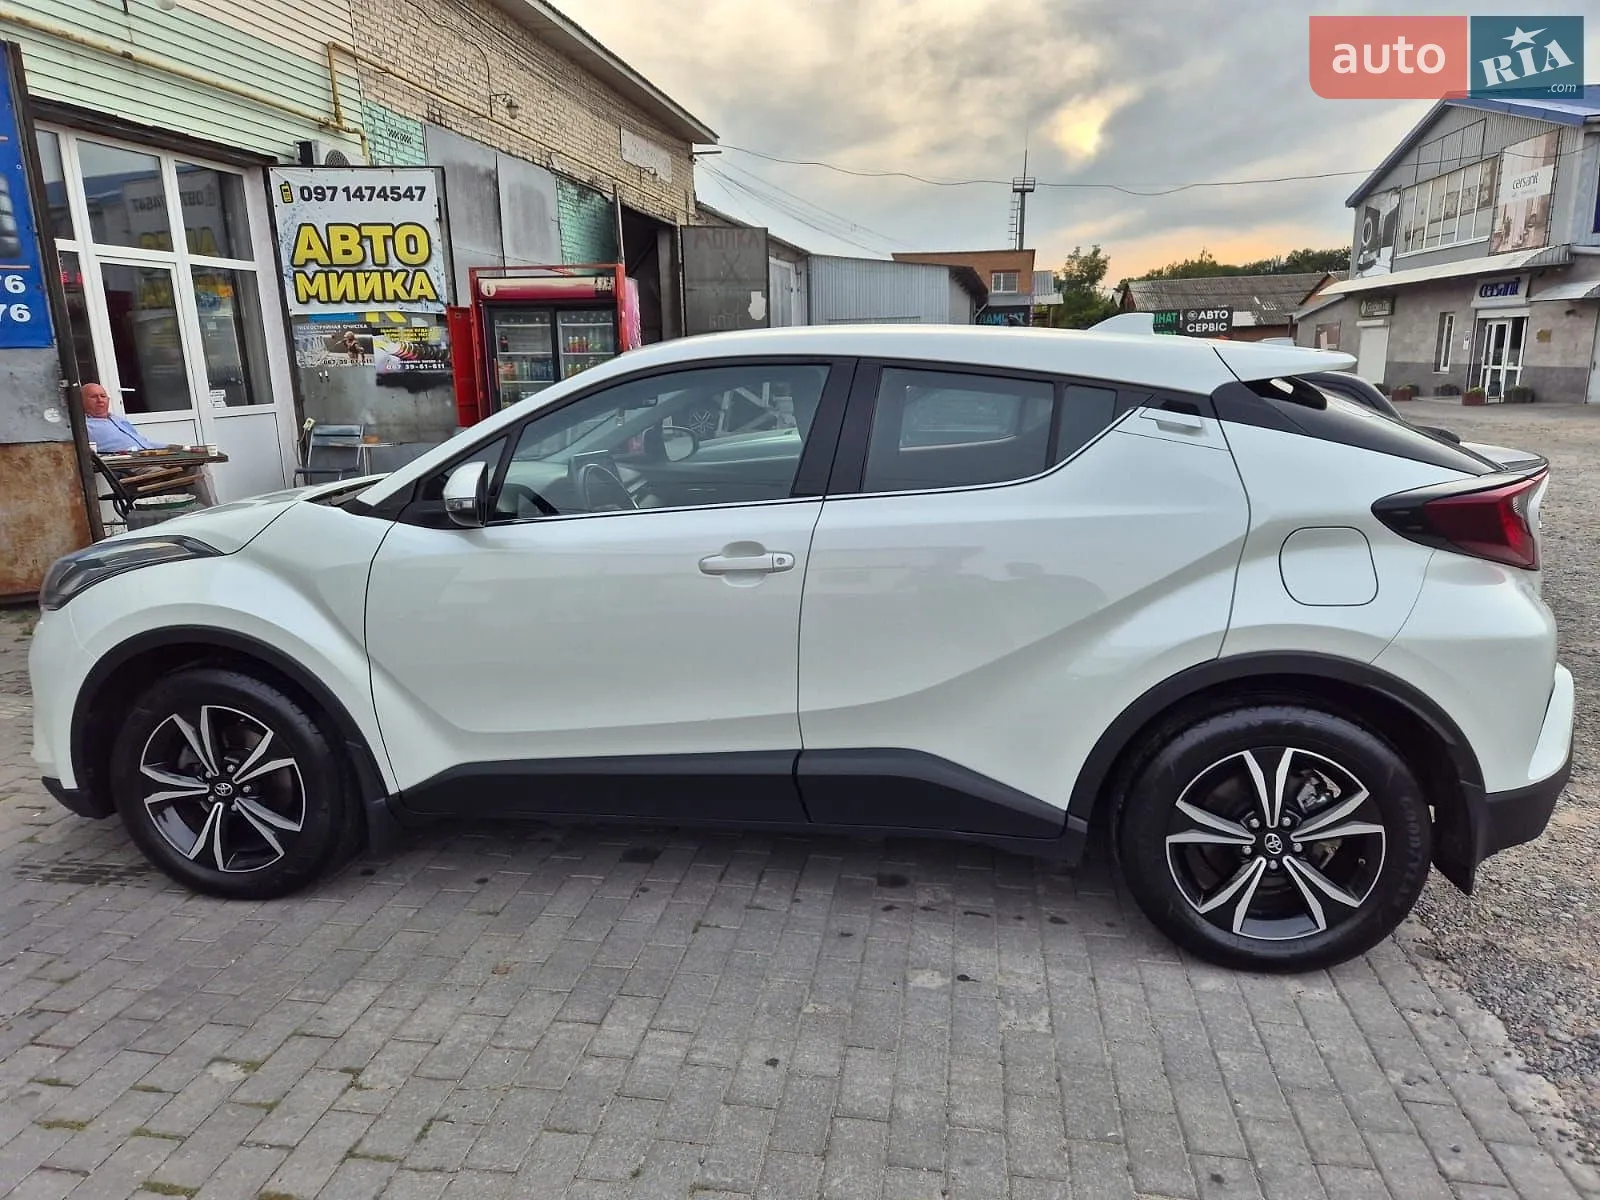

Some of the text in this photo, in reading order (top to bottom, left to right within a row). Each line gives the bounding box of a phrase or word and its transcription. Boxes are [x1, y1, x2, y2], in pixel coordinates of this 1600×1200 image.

[299, 185, 427, 202] 097 1474547
[290, 222, 432, 268] АВТО
[293, 269, 440, 304] МИЙКА
[1198, 310, 1229, 320] АВТО
[1186, 322, 1228, 333] СЕРВІС
